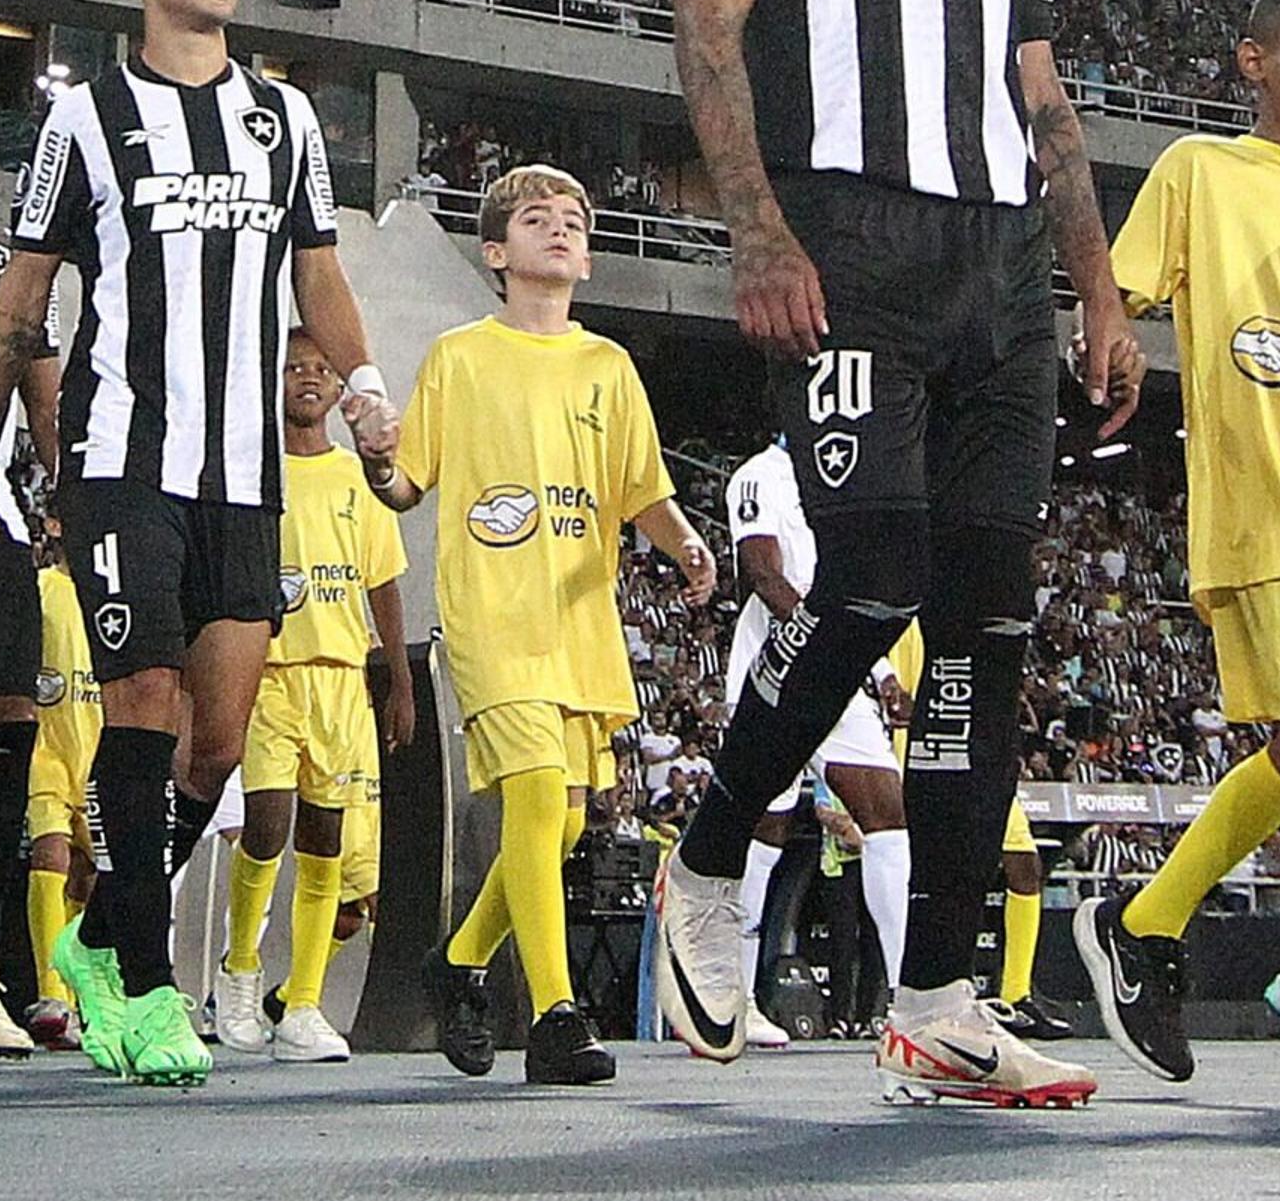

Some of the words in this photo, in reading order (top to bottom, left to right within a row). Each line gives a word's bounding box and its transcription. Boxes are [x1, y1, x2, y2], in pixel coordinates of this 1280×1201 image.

[25, 129, 61, 223] Centrum
[132, 173, 245, 207] PARI
[149, 201, 286, 234] MATCH
[807, 349, 874, 425] 20
[93, 532, 122, 595] 4
